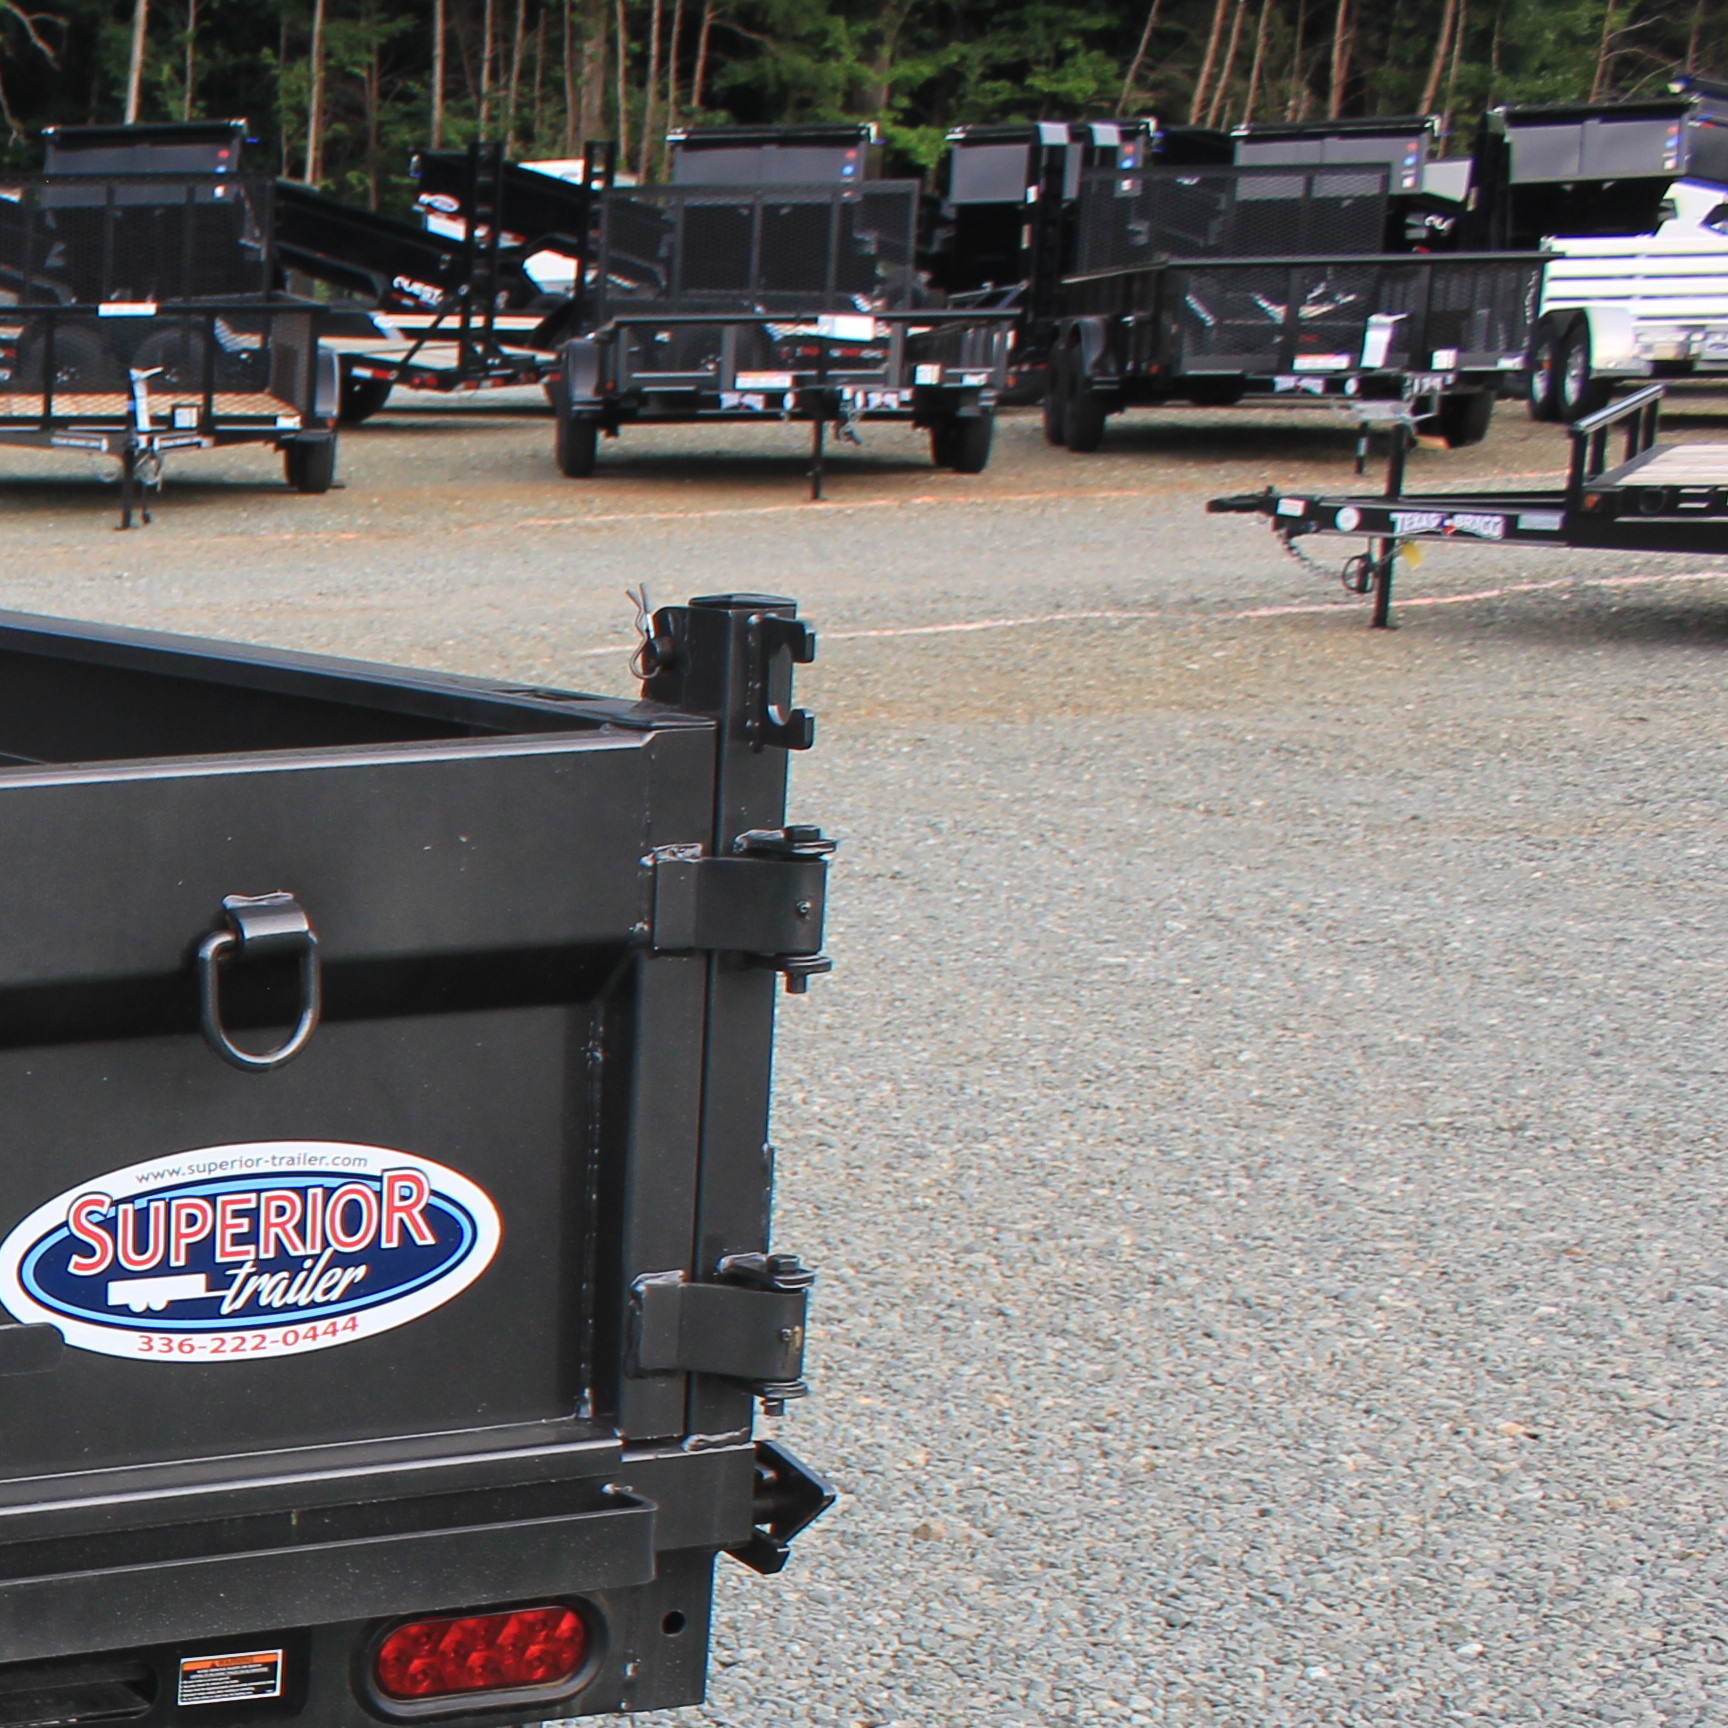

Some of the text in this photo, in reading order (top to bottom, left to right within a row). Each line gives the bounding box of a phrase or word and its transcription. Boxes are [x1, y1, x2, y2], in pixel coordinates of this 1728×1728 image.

[1389, 511, 1445, 536] TEXAS
[134, 1152, 368, 1184] www.superior-trailer.com
[66, 1168, 437, 1277] SUPERIOR
[220, 1249, 367, 1315] trailer
[137, 1315, 360, 1355] 336-222-0444
